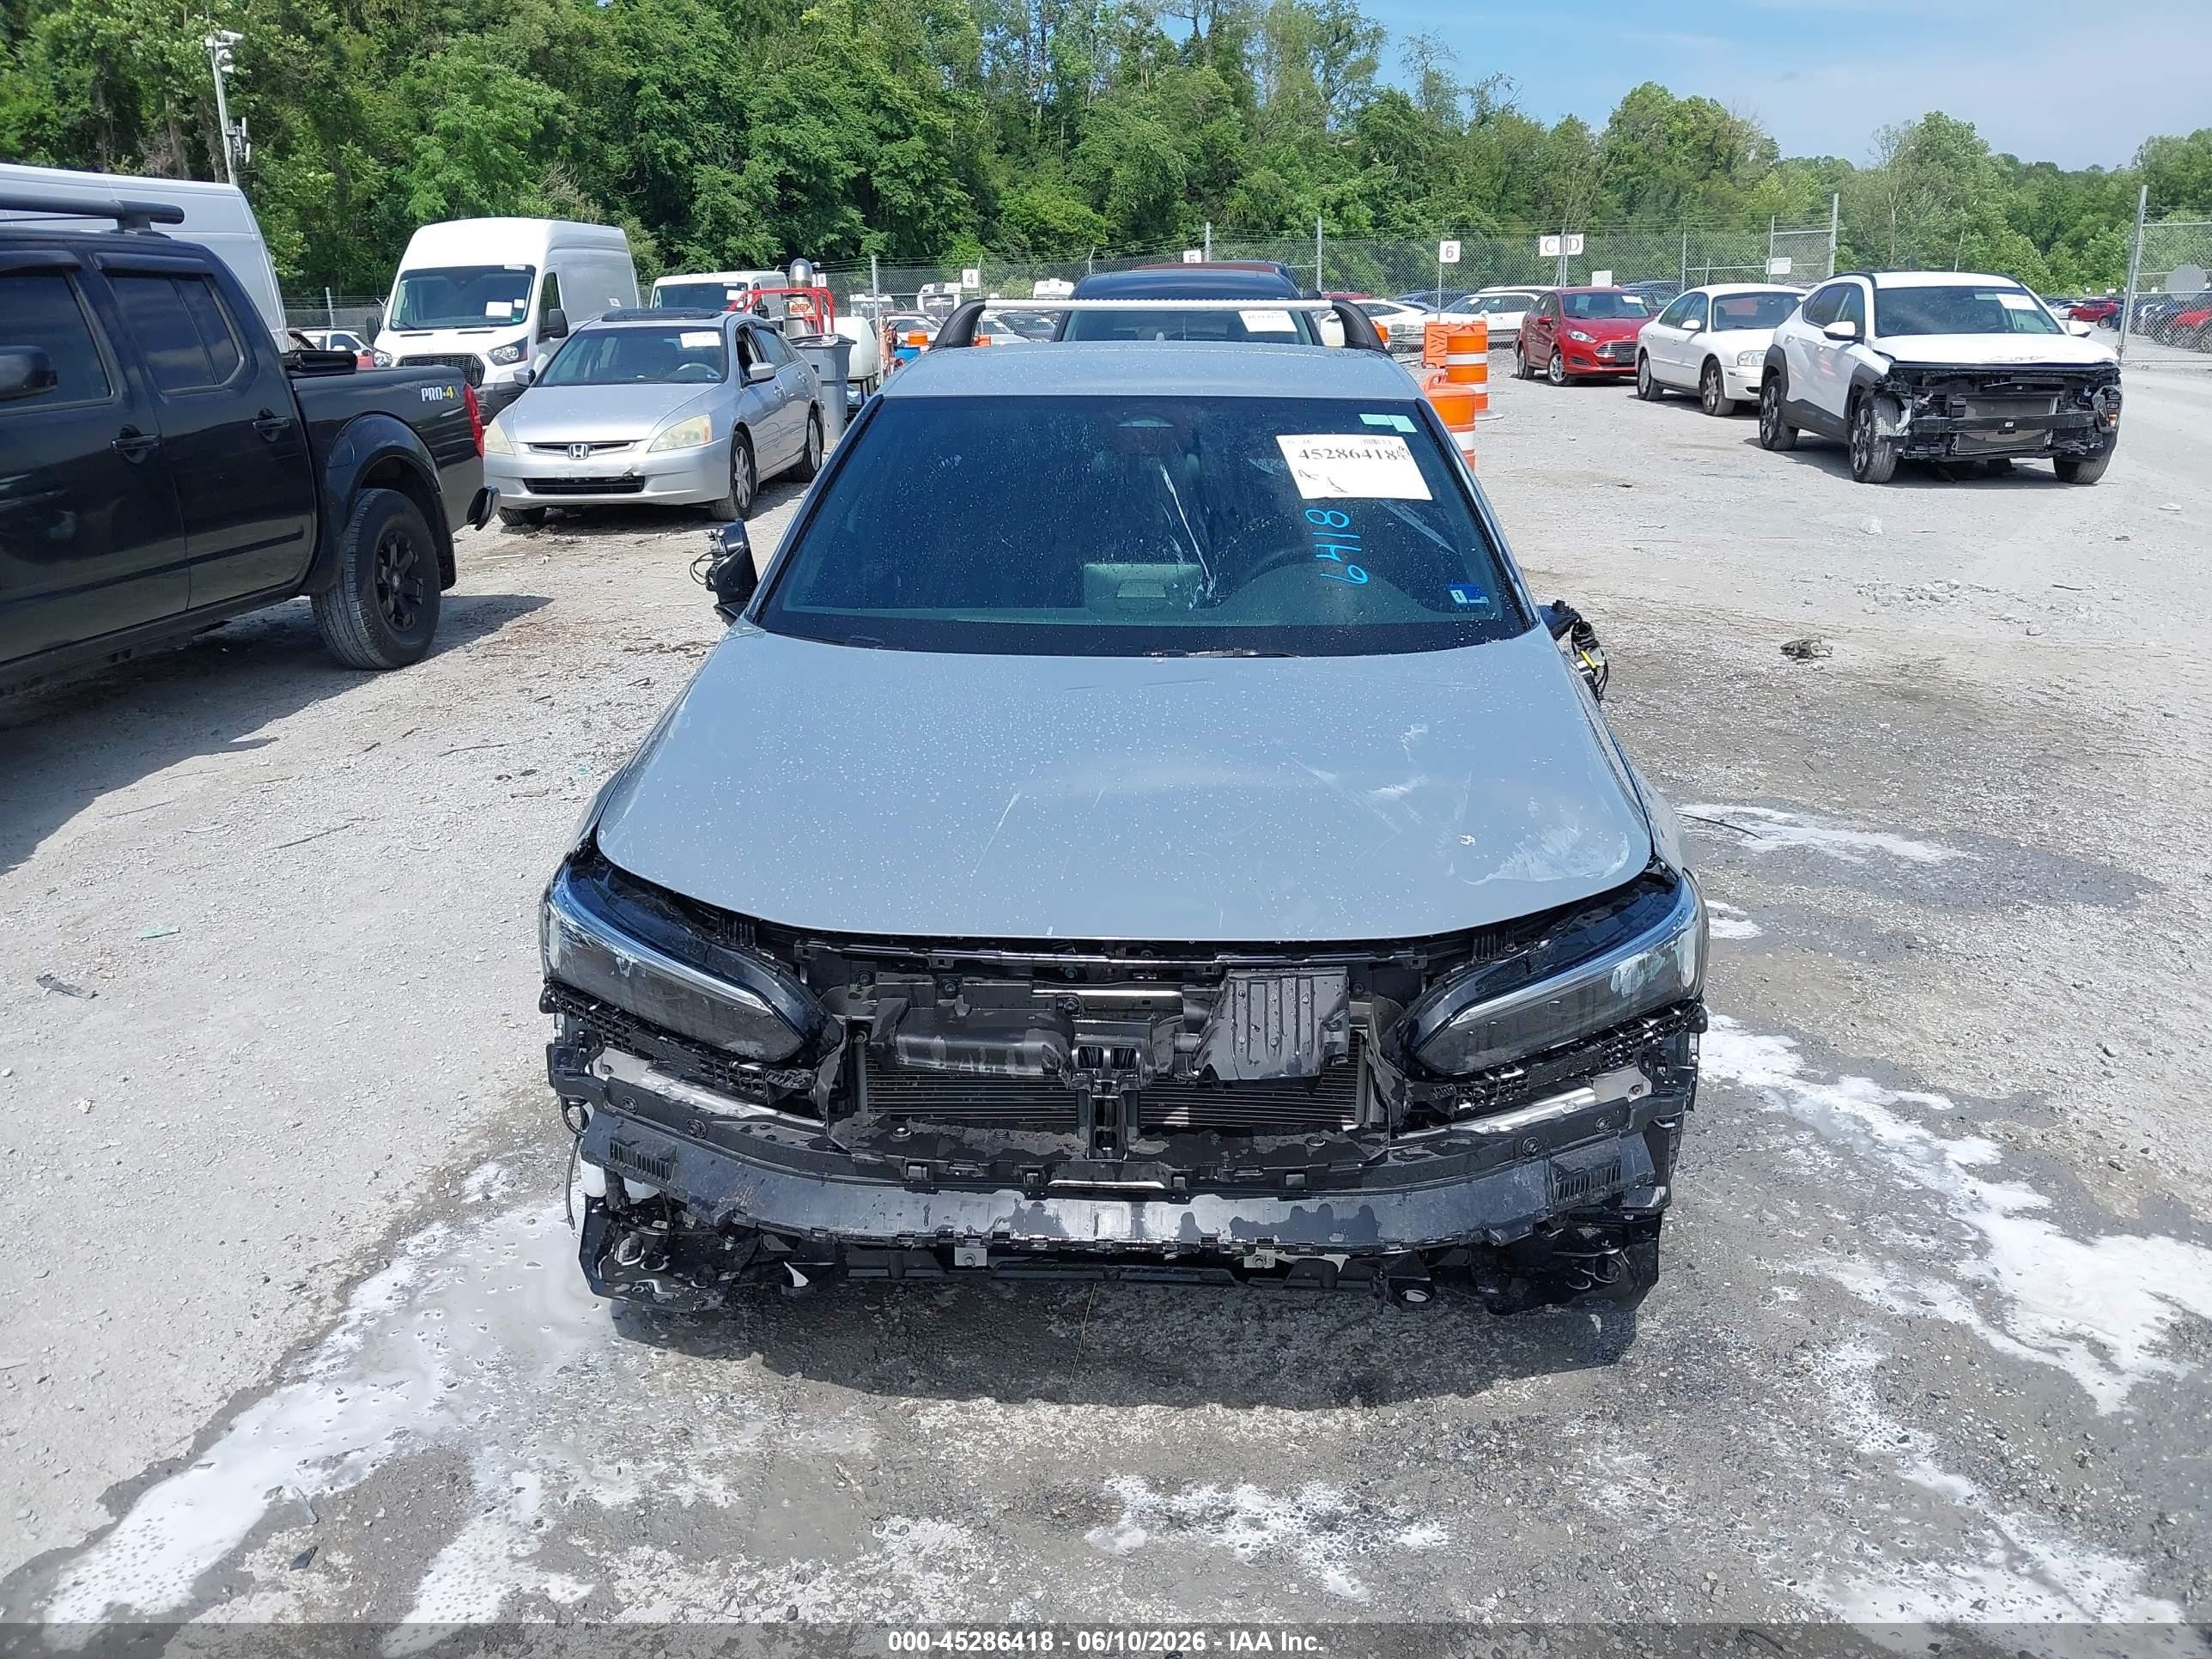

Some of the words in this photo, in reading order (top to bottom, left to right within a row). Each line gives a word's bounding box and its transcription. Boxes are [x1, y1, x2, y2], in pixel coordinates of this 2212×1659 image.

[1445, 245, 1455, 258] 6
[1545, 239, 1556, 252] C
[1567, 238, 1579, 252] D
[967, 272, 975, 284] 4
[1297, 447, 1398, 461] 45286418
[1305, 509, 1368, 584] 6418
